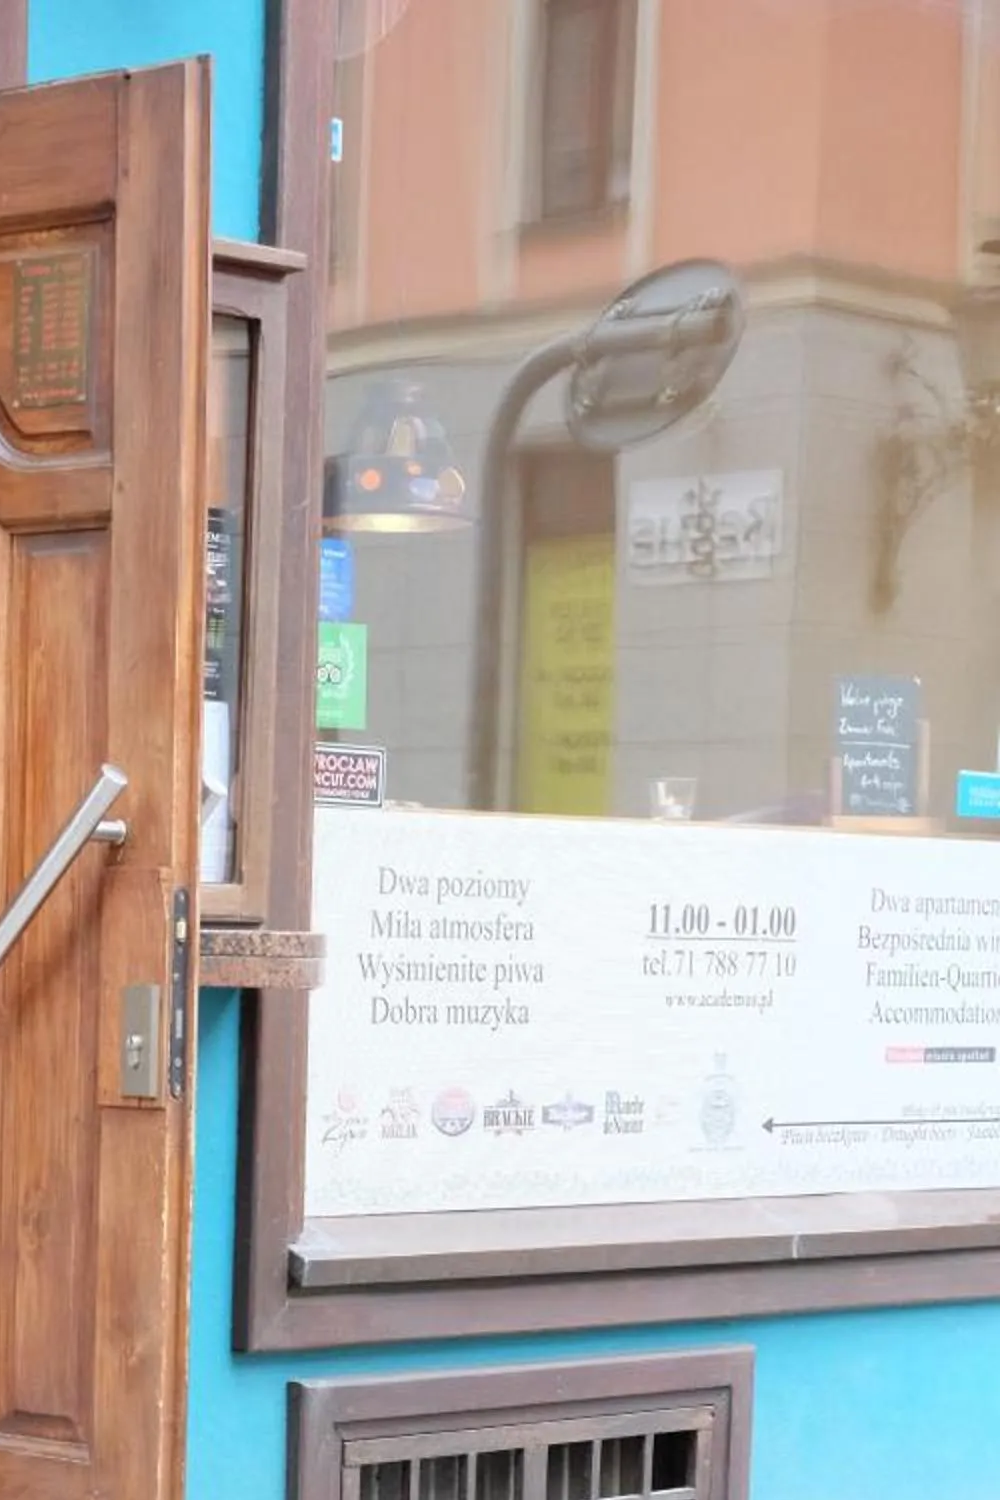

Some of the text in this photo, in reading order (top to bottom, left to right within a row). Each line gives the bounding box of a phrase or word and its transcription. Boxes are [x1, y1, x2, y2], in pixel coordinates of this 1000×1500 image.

[377, 865, 532, 907] Dwa poziomy
[871, 886, 911, 914] Dwa
[429, 911, 535, 941] atmosfera
[650, 903, 797, 937] 11.00 - 01.00
[357, 951, 544, 990] Wyśmienite piwa
[704, 949, 738, 977] 788
[746, 950, 769, 977] 77
[776, 950, 797, 977] 10
[371, 995, 530, 1031] Dobra muzyka
